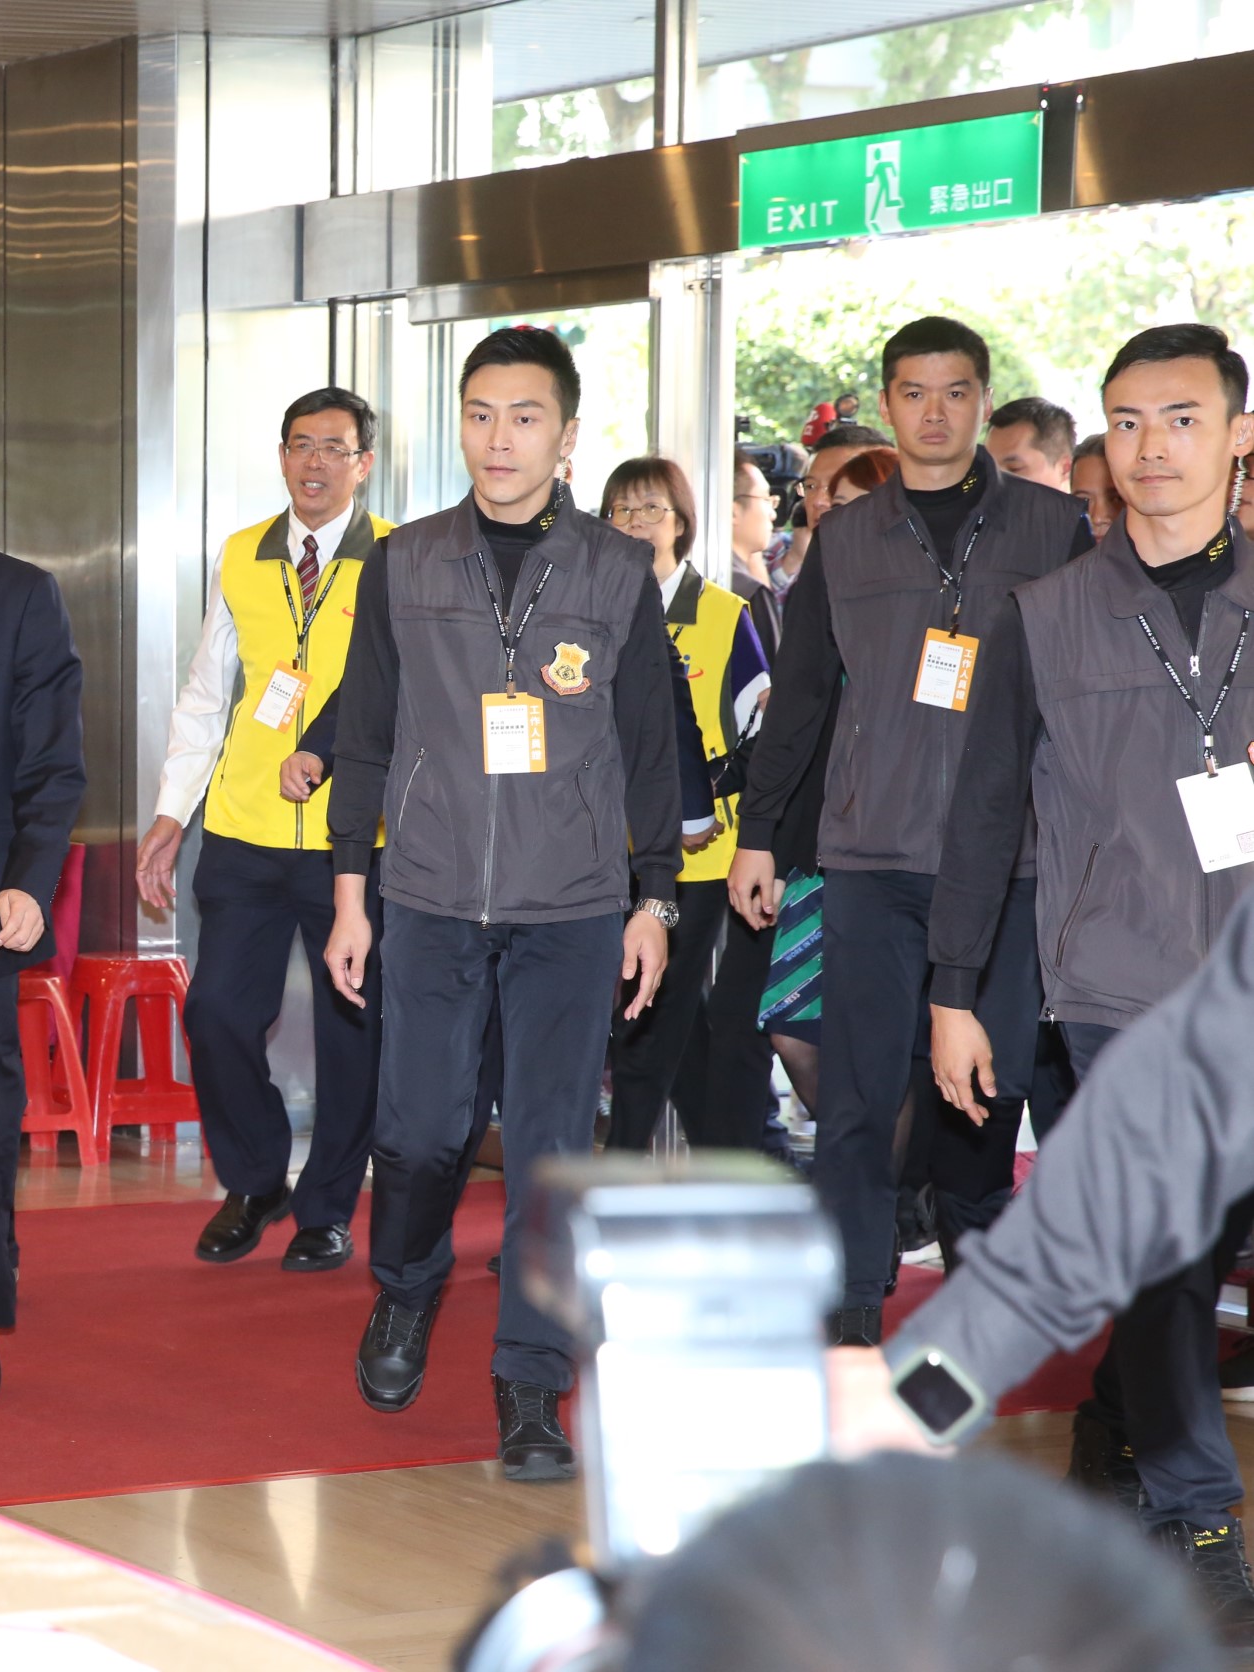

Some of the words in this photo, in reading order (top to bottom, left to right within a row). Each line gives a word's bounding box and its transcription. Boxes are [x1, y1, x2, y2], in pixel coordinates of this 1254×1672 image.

[929, 177, 1014, 215] 緊急出口
[767, 200, 839, 234] EXIT
